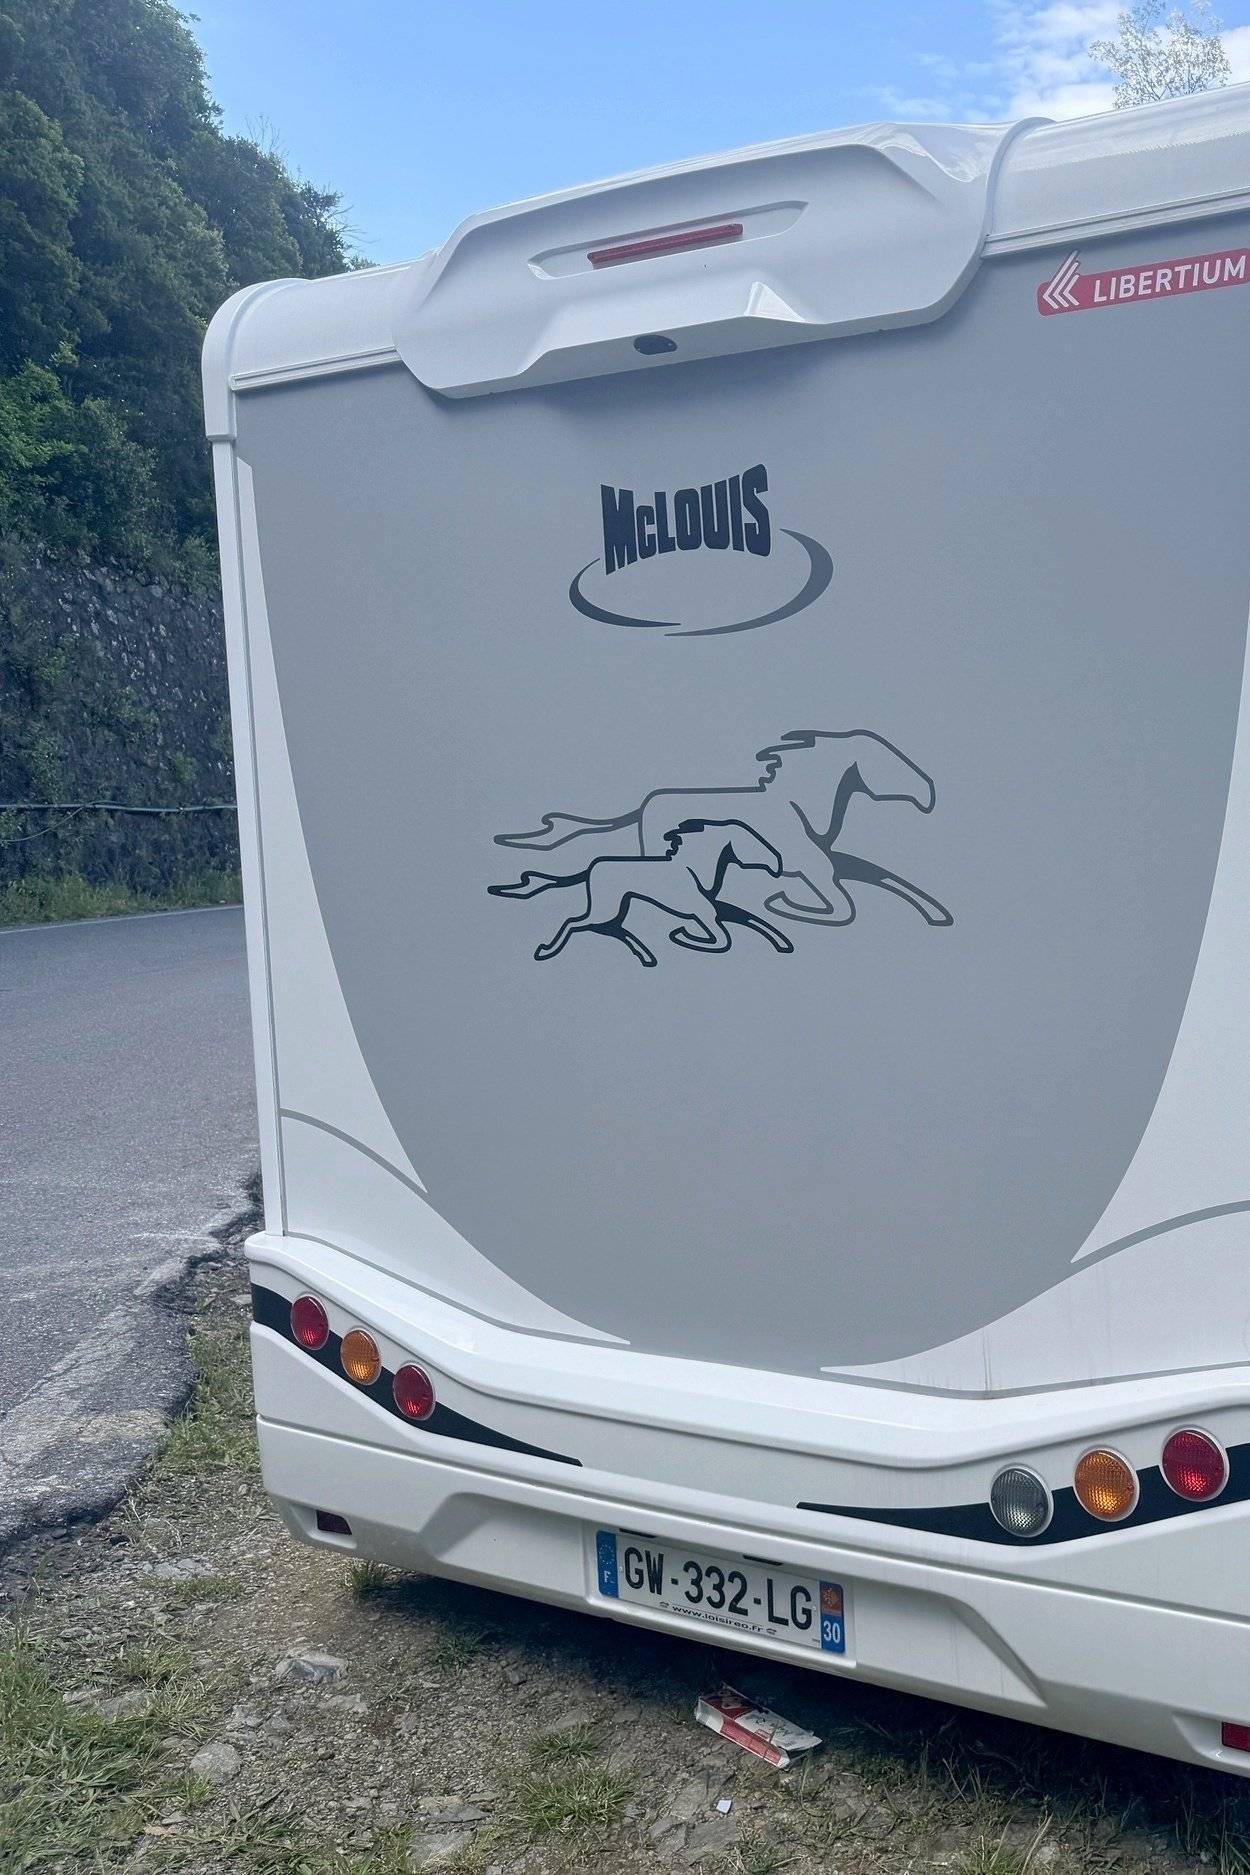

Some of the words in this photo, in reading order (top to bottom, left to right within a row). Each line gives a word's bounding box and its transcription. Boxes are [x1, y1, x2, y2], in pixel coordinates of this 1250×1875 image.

[1094, 255, 1246, 302] LIBERTIUM
[624, 1546, 812, 1630] GW-332-LG
[823, 1620, 841, 1644] 30
